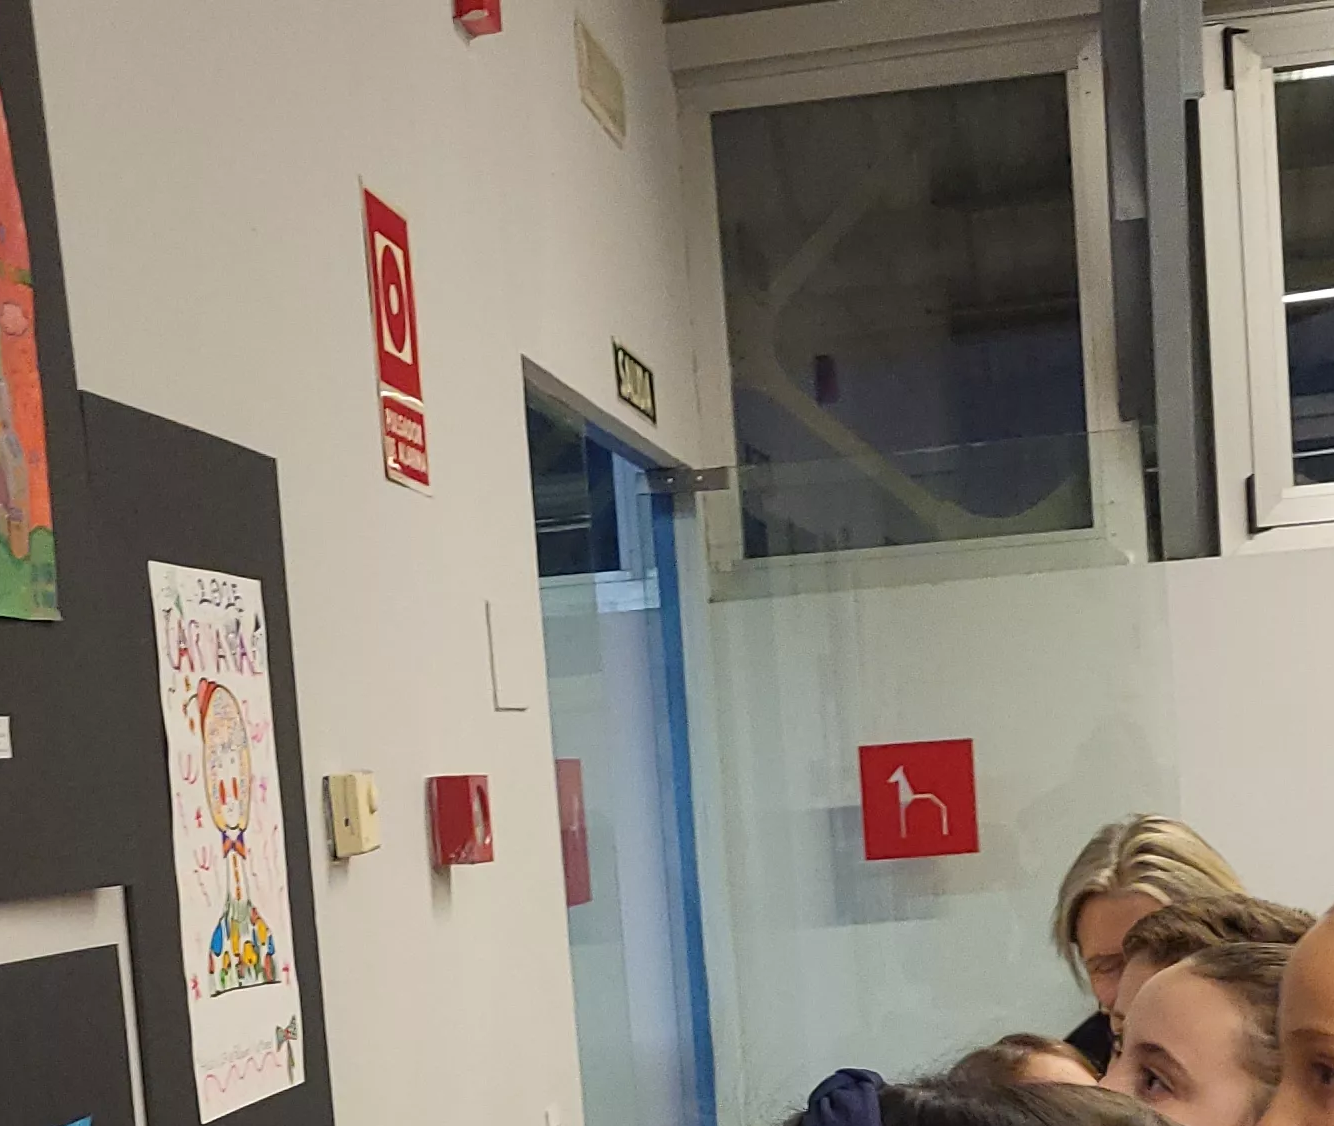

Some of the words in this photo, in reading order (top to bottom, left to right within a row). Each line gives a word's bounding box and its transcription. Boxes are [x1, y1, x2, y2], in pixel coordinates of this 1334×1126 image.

[617, 348, 652, 411] SALIDA
[384, 406, 424, 447] PULSADOR
[398, 441, 429, 474] ALARMA
